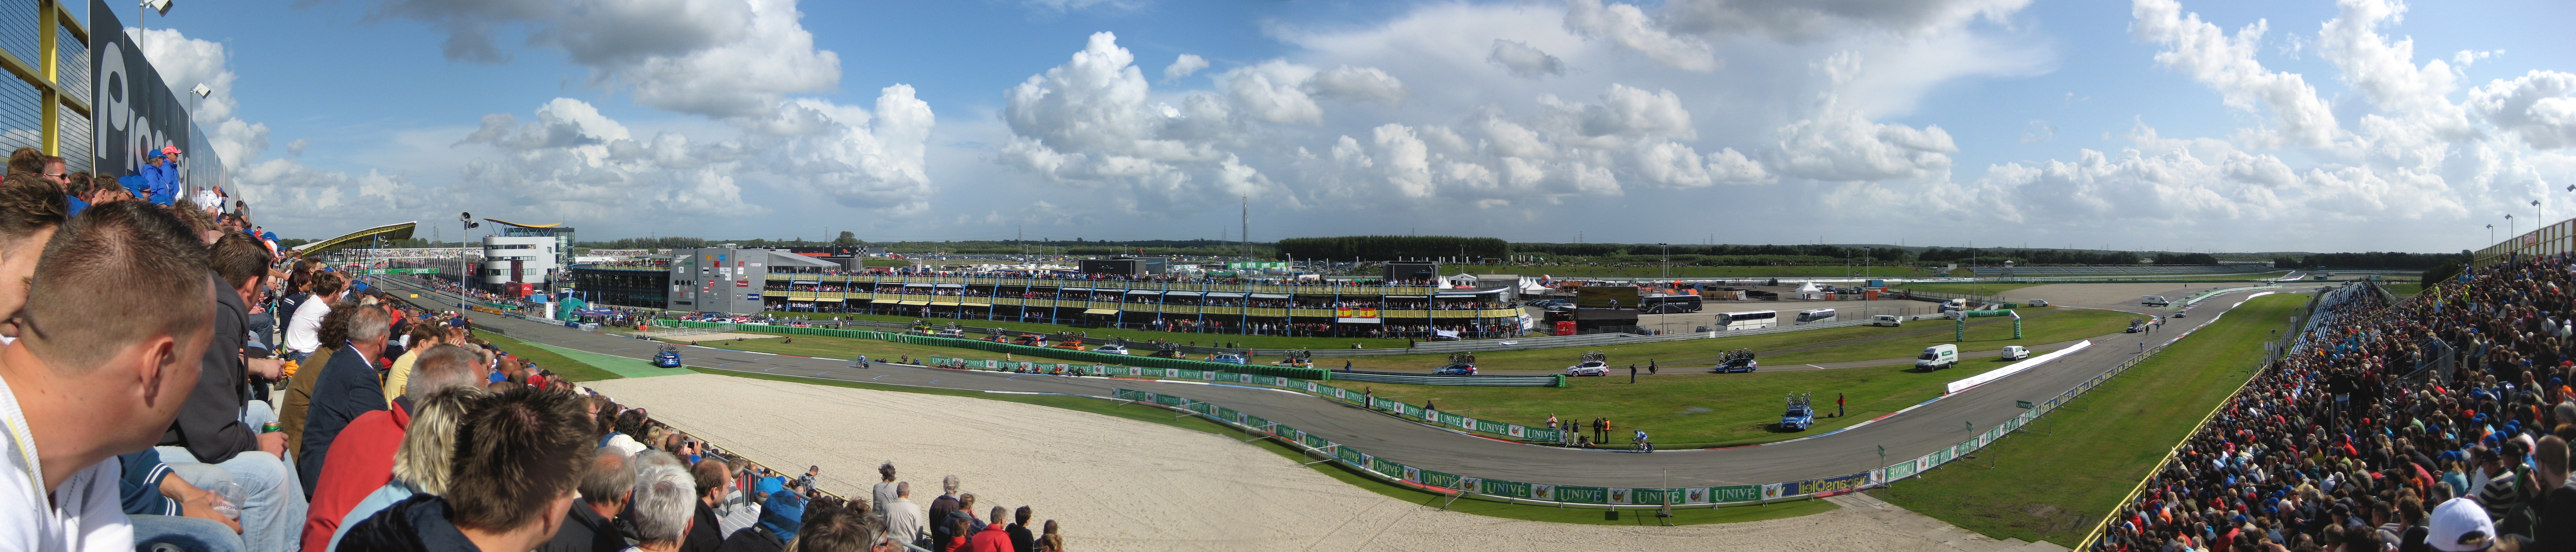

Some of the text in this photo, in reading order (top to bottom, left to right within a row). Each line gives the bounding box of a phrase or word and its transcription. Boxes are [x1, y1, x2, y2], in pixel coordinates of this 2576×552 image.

[1144, 368, 1164, 376] UNIVÉ
[1180, 371, 1201, 379] UNIVÉ
[1217, 373, 1238, 381] UNIVÉ
[1254, 376, 1275, 385] UNIVÉ
[1289, 380, 1307, 390] UNIVÉ
[1122, 391, 1143, 400] UNIVÉ
[1319, 386, 1334, 396] UNIVÉ
[1158, 396, 1178, 406] UNIVÉ
[1347, 392, 1363, 402] UNIVÉ
[1192, 402, 1208, 413] UNIVÉ
[1375, 399, 1393, 410] UNIVÉ
[1220, 409, 1236, 420] UNIVÉ
[1406, 406, 1423, 418] UNIVÉ
[1249, 417, 1266, 430] UNIVÉ
[1441, 414, 1461, 426] UNIVÉ
[1278, 426, 1295, 440] UNIVÉ
[1479, 422, 1505, 434] UNIVÉ
[1527, 429, 1556, 441] UNIVÉ
[1308, 436, 1327, 452] UNIVÉ
[1340, 447, 1360, 463] UNIVÉ
[1377, 462, 1401, 477] UNIVÉ
[1423, 473, 1457, 489] UNIVÉ
[1487, 482, 1526, 497] UNIVÉ
[1560, 488, 1602, 502] UNIVÉ
[1714, 485, 1756, 501] UNIVÉ
[218, 501, 239, 510] Bavaria
